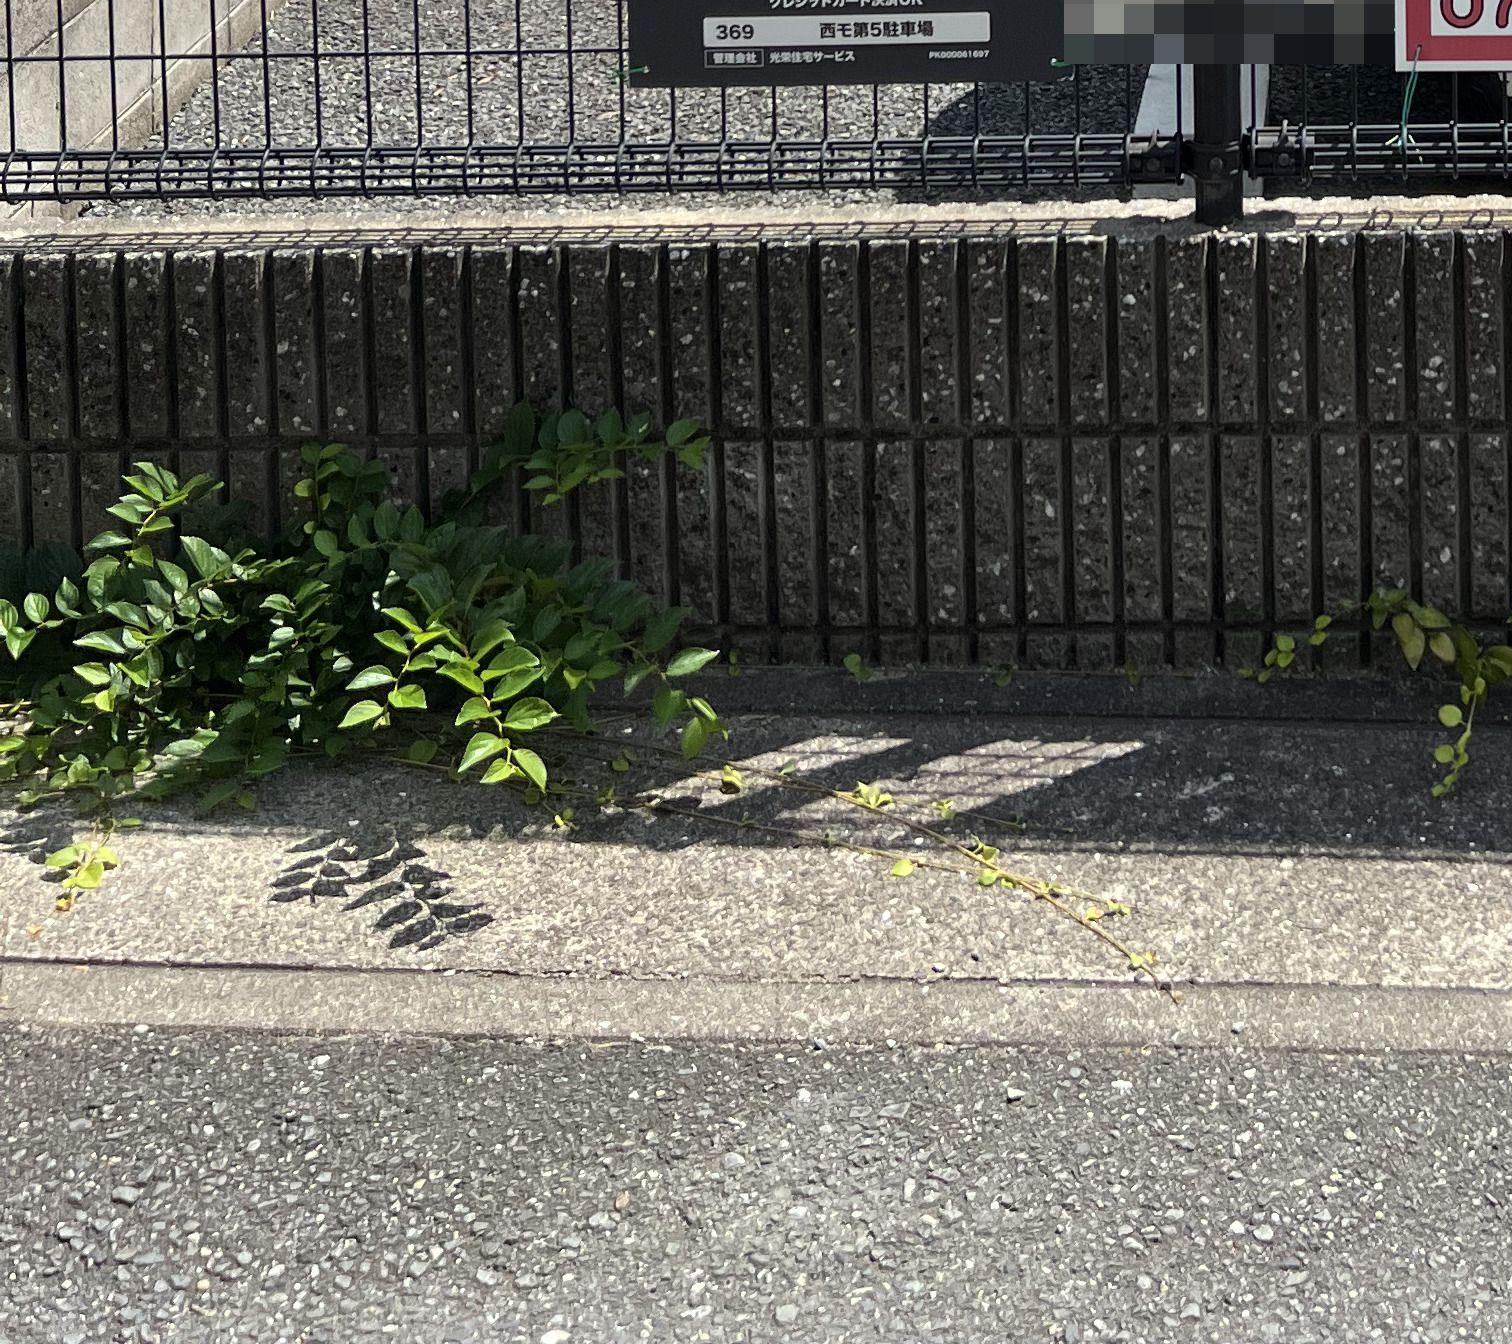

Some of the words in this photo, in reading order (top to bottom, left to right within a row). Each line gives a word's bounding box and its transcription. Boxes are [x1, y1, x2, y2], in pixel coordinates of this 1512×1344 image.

[716, 24, 755, 40] 369
[819, 21, 934, 39] 西モ第5駐車場
[713, 52, 757, 65] 管理会社
[769, 50, 856, 64] 光栄住宅サービス
